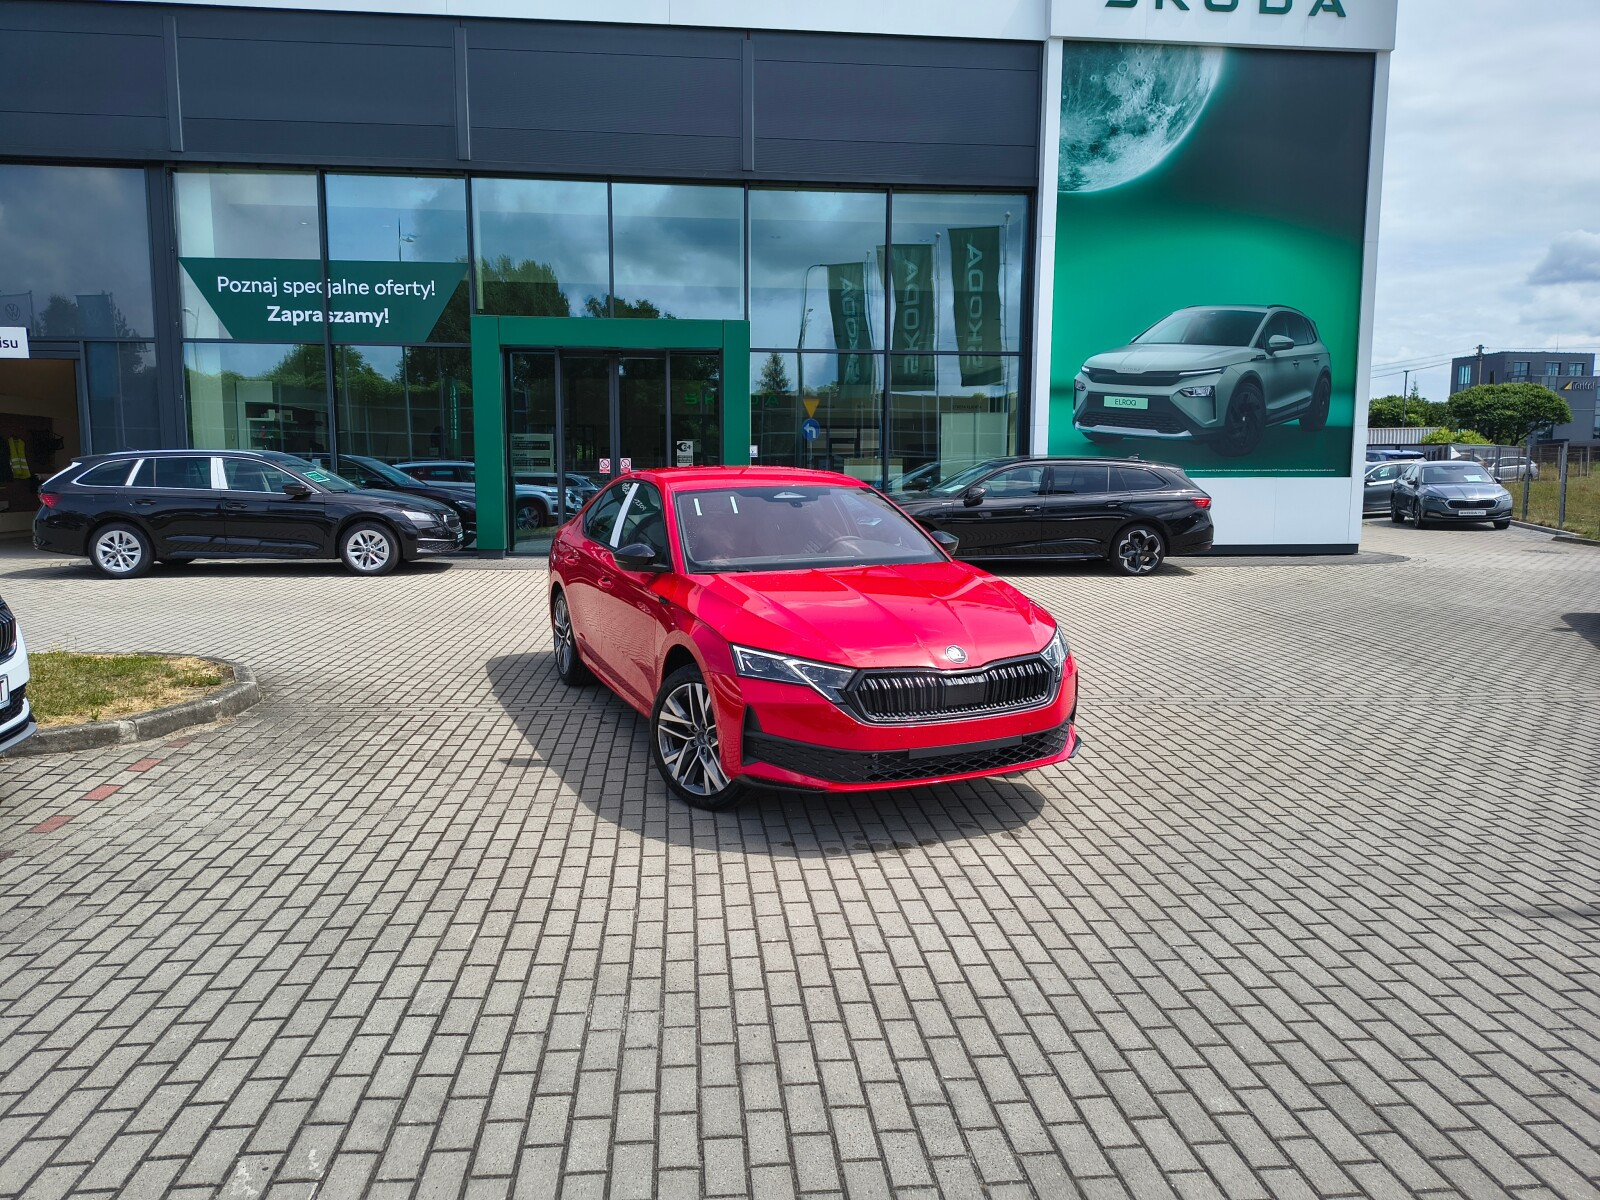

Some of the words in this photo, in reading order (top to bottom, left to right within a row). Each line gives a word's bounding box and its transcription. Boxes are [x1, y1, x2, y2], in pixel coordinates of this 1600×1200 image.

[217, 276, 278, 297] Poznaj
[283, 278, 370, 298] specjalne
[374, 279, 436, 300] oferty!
[266, 305, 389, 327] Zapraszamy!
[1114, 398, 1137, 406] ELROQ
